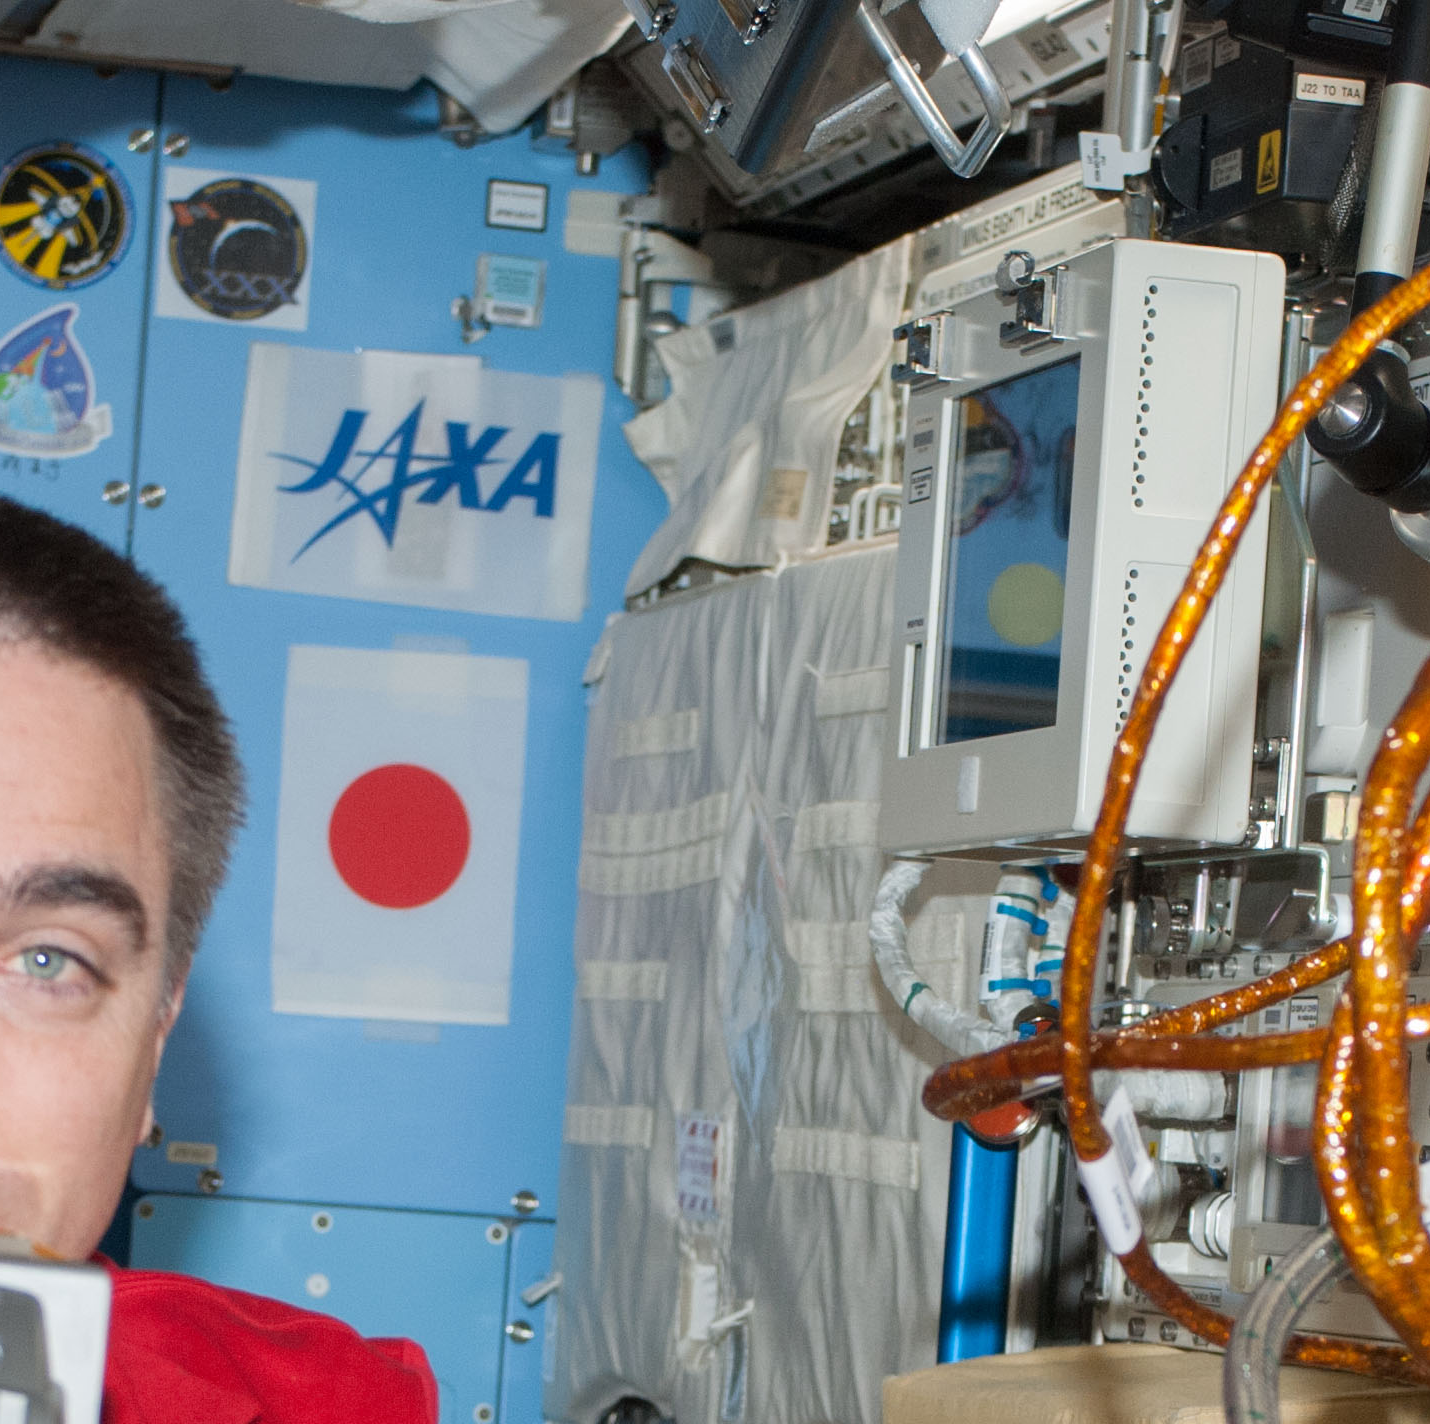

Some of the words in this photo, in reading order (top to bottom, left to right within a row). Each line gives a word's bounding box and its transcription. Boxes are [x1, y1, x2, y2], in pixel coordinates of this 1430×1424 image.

[1300, 82, 1317, 95] J22
[1322, 84, 1336, 96] TO
[1342, 86, 1361, 99] TAA
[1027, 193, 1048, 224] LAB
[268, 397, 564, 565] JAXA
